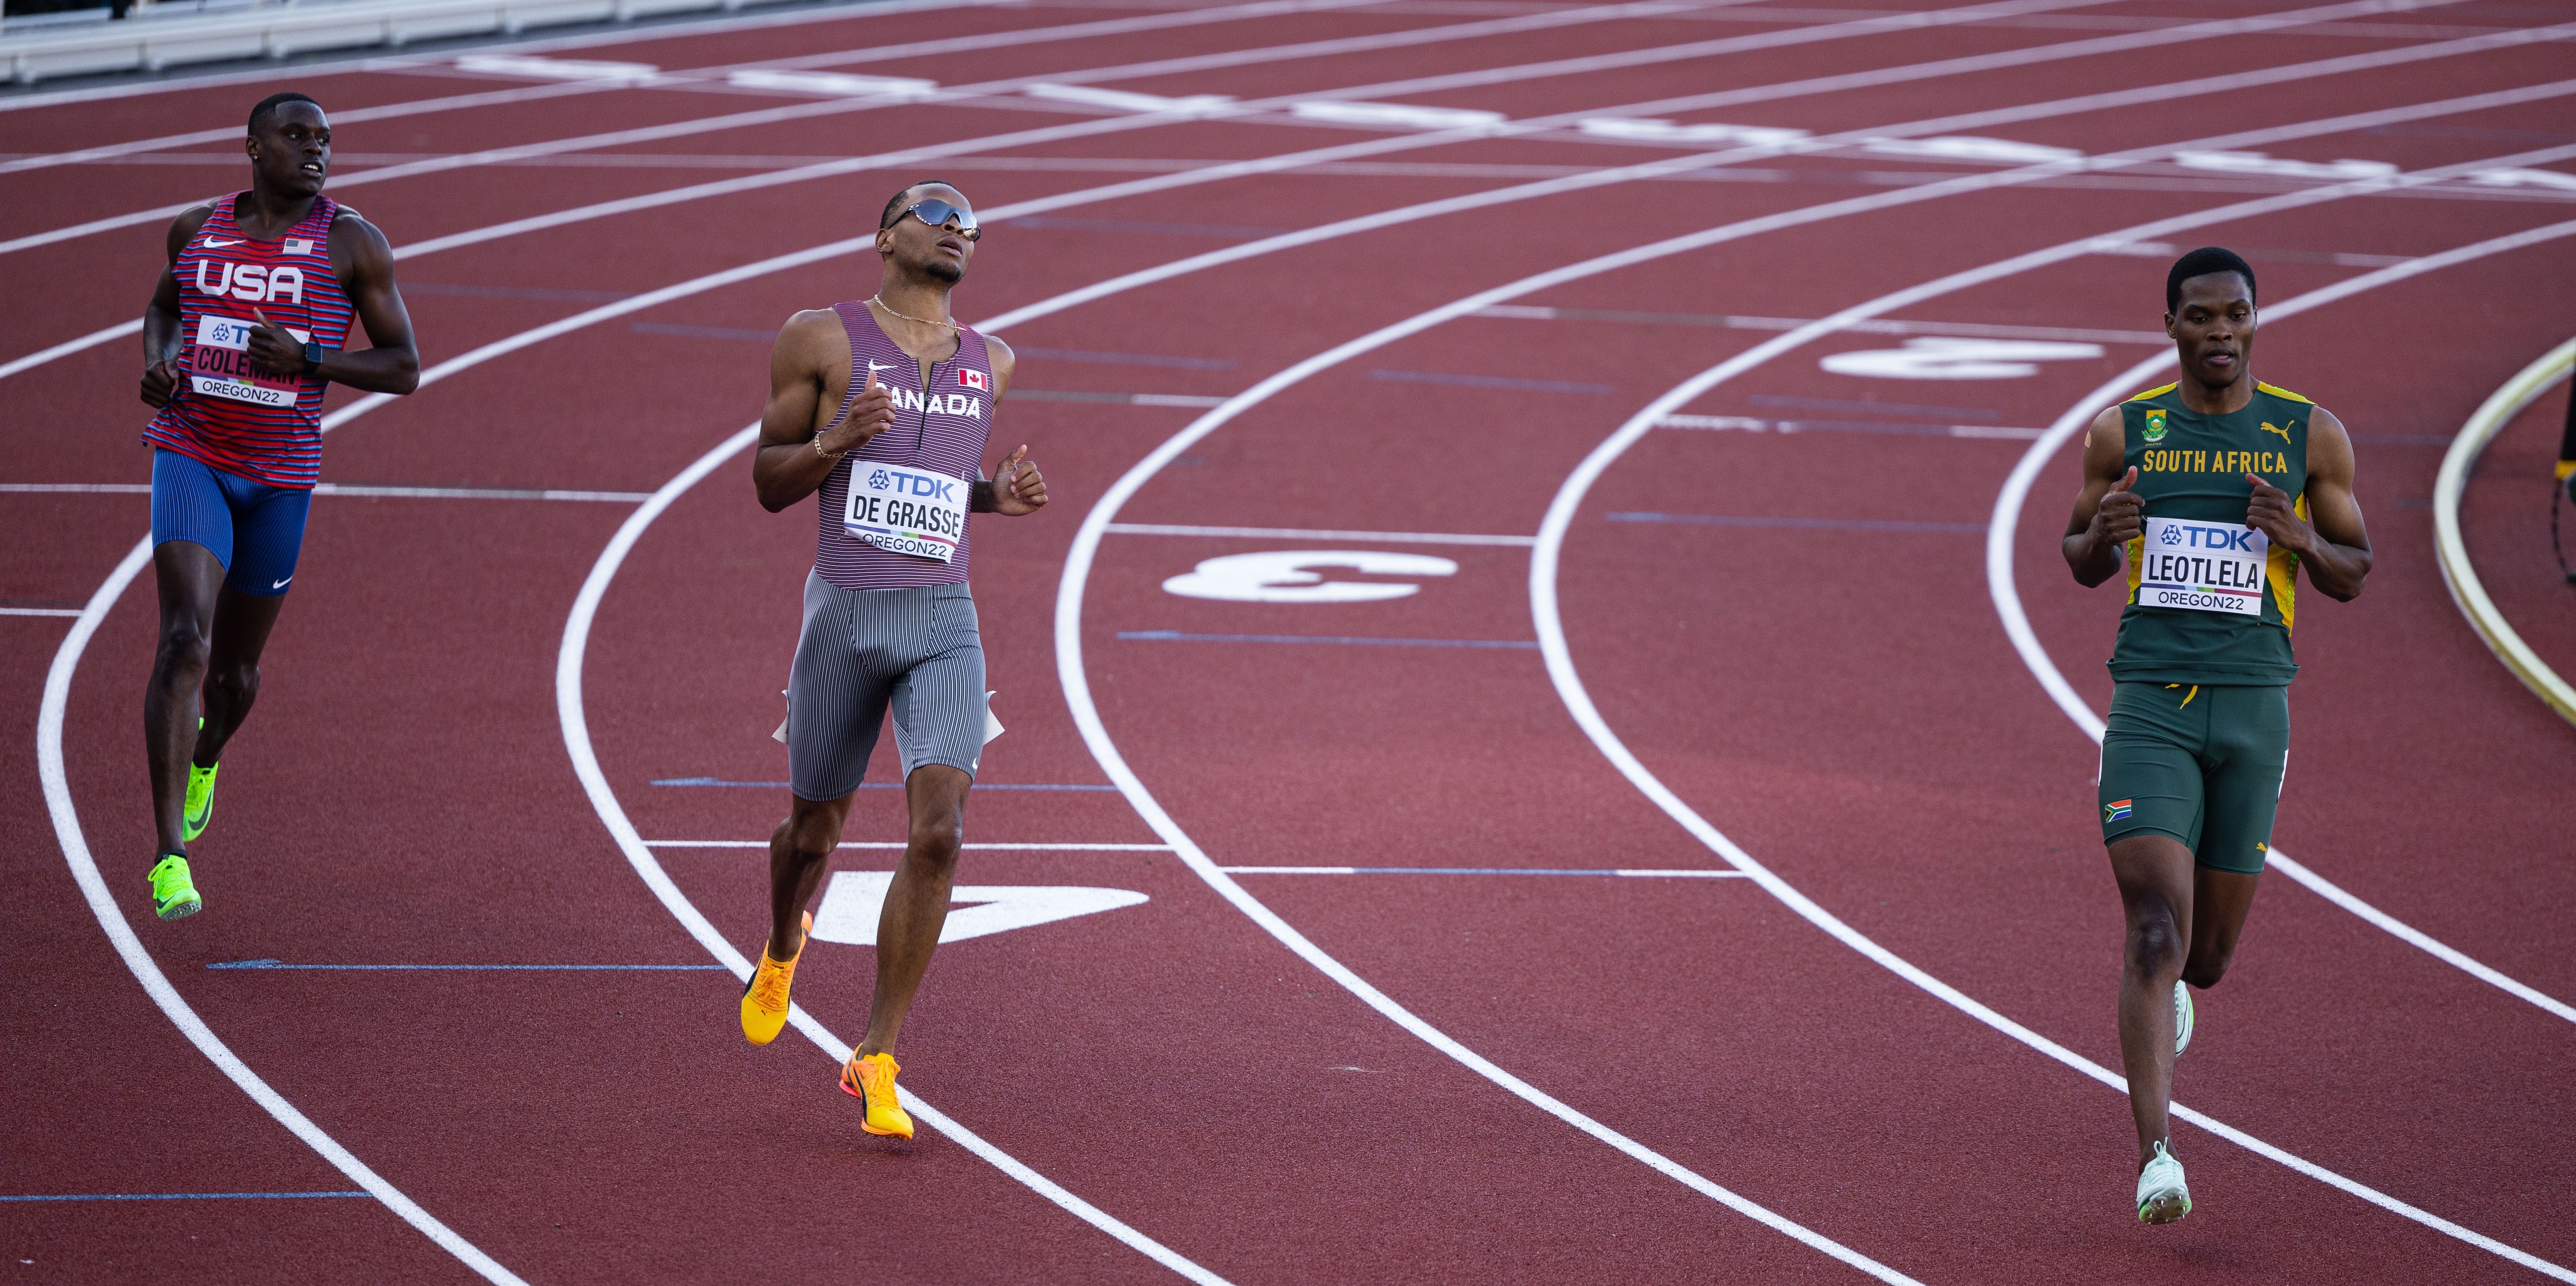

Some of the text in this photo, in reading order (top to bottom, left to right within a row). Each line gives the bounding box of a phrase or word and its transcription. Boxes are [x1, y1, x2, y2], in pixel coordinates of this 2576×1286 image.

[196, 259, 303, 304] USA
[203, 381, 279, 403] OREGON22
[2143, 450, 2287, 473] SOUTH AFRICA
[890, 471, 954, 502] TDK
[853, 496, 960, 538] DE GRASSE
[863, 533, 947, 557] OREGON22
[2182, 526, 2253, 552] TDK
[1161, 550, 1458, 602] 3
[2148, 554, 2258, 589] LEOTLELA
[2158, 591, 2244, 610] OREGON22
[809, 871, 1150, 945] 4
